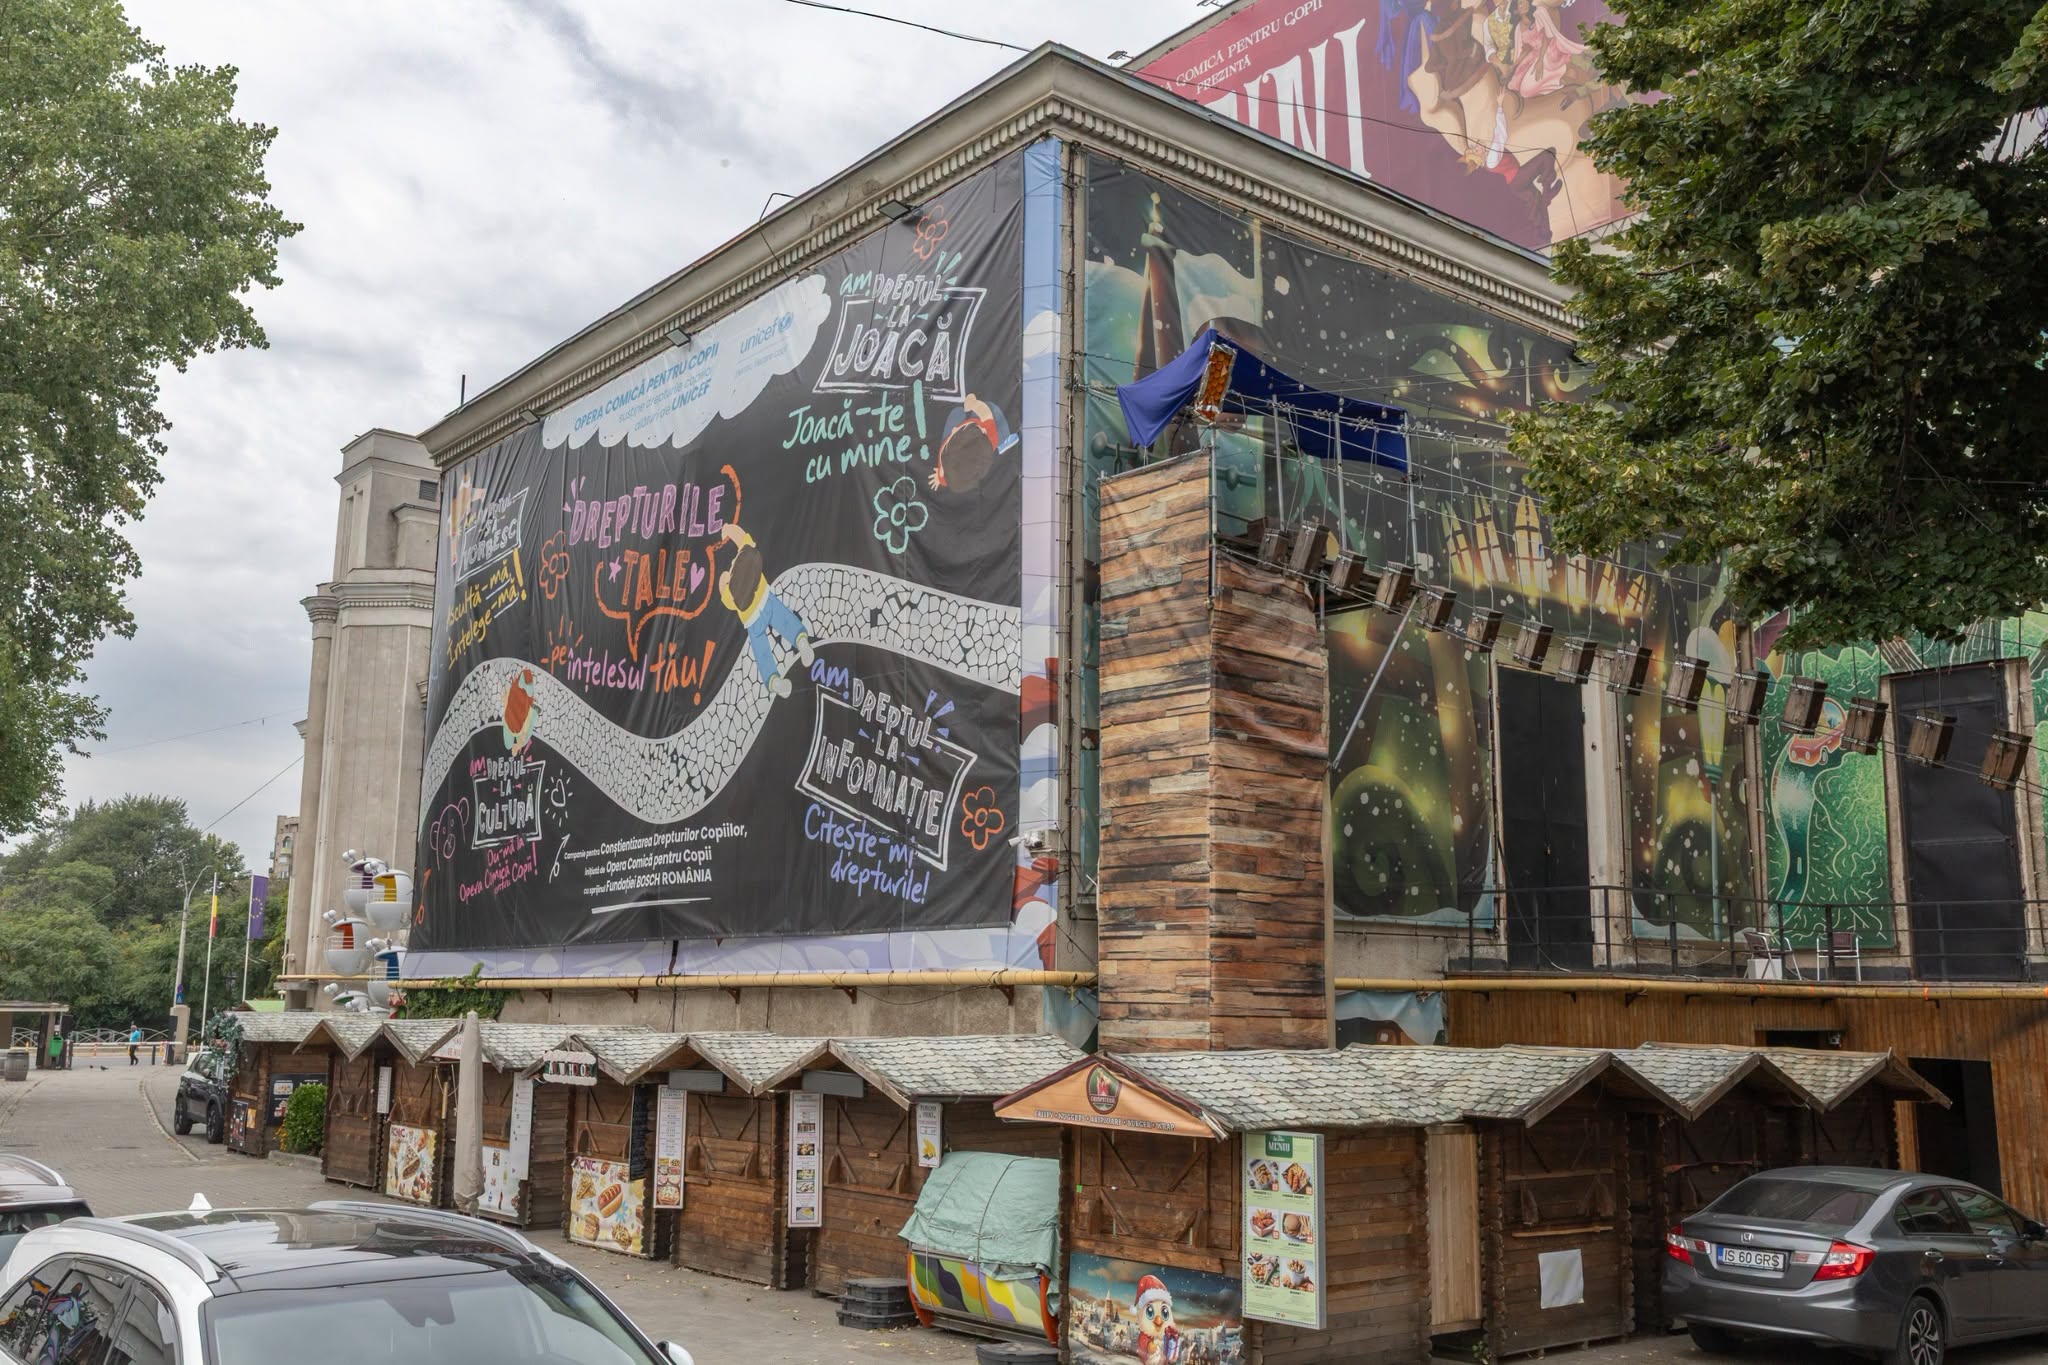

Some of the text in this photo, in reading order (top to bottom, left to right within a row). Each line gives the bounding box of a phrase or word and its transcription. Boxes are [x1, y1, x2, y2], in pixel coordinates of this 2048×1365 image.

[1227, 18, 1280, 58] PENTRU
[872, 273, 943, 307] DREPTUL
[887, 305, 911, 329] LA
[740, 316, 779, 354] unicef
[834, 312, 953, 382] JOACĂ
[574, 406, 604, 432] OPERA
[605, 378, 647, 416] COMICĂ
[647, 360, 688, 393] PENTRU
[688, 342, 720, 371] COPII
[671, 378, 713, 411] UNICEF
[806, 454, 832, 484] cu
[569, 483, 725, 549] DREPTURILE
[621, 548, 691, 611] TALE
[567, 647, 649, 693] înțelesul
[852, 677, 934, 749] DREPTUL
[874, 729, 899, 762] LA
[486, 754, 527, 781] DREPTUL
[500, 778, 512, 797] LA
[477, 783, 535, 835] CULTURĂ
[600, 835, 653, 858] Conștientizarea
[653, 829, 700, 850] Drepturilor
[700, 822, 748, 843] Copiilor,
[606, 860, 626, 877] Opera
[627, 853, 653, 870] Comică
[652, 851, 683, 869] pentru
[683, 845, 713, 865] Copii
[636, 872, 661, 888] BOSCH
[661, 866, 713, 885] ROMÂNIA
[830, 850, 931, 905] drepturile!
[460, 880, 483, 905] Opera
[1724, 1249, 1780, 1267] IS 60 GRS
